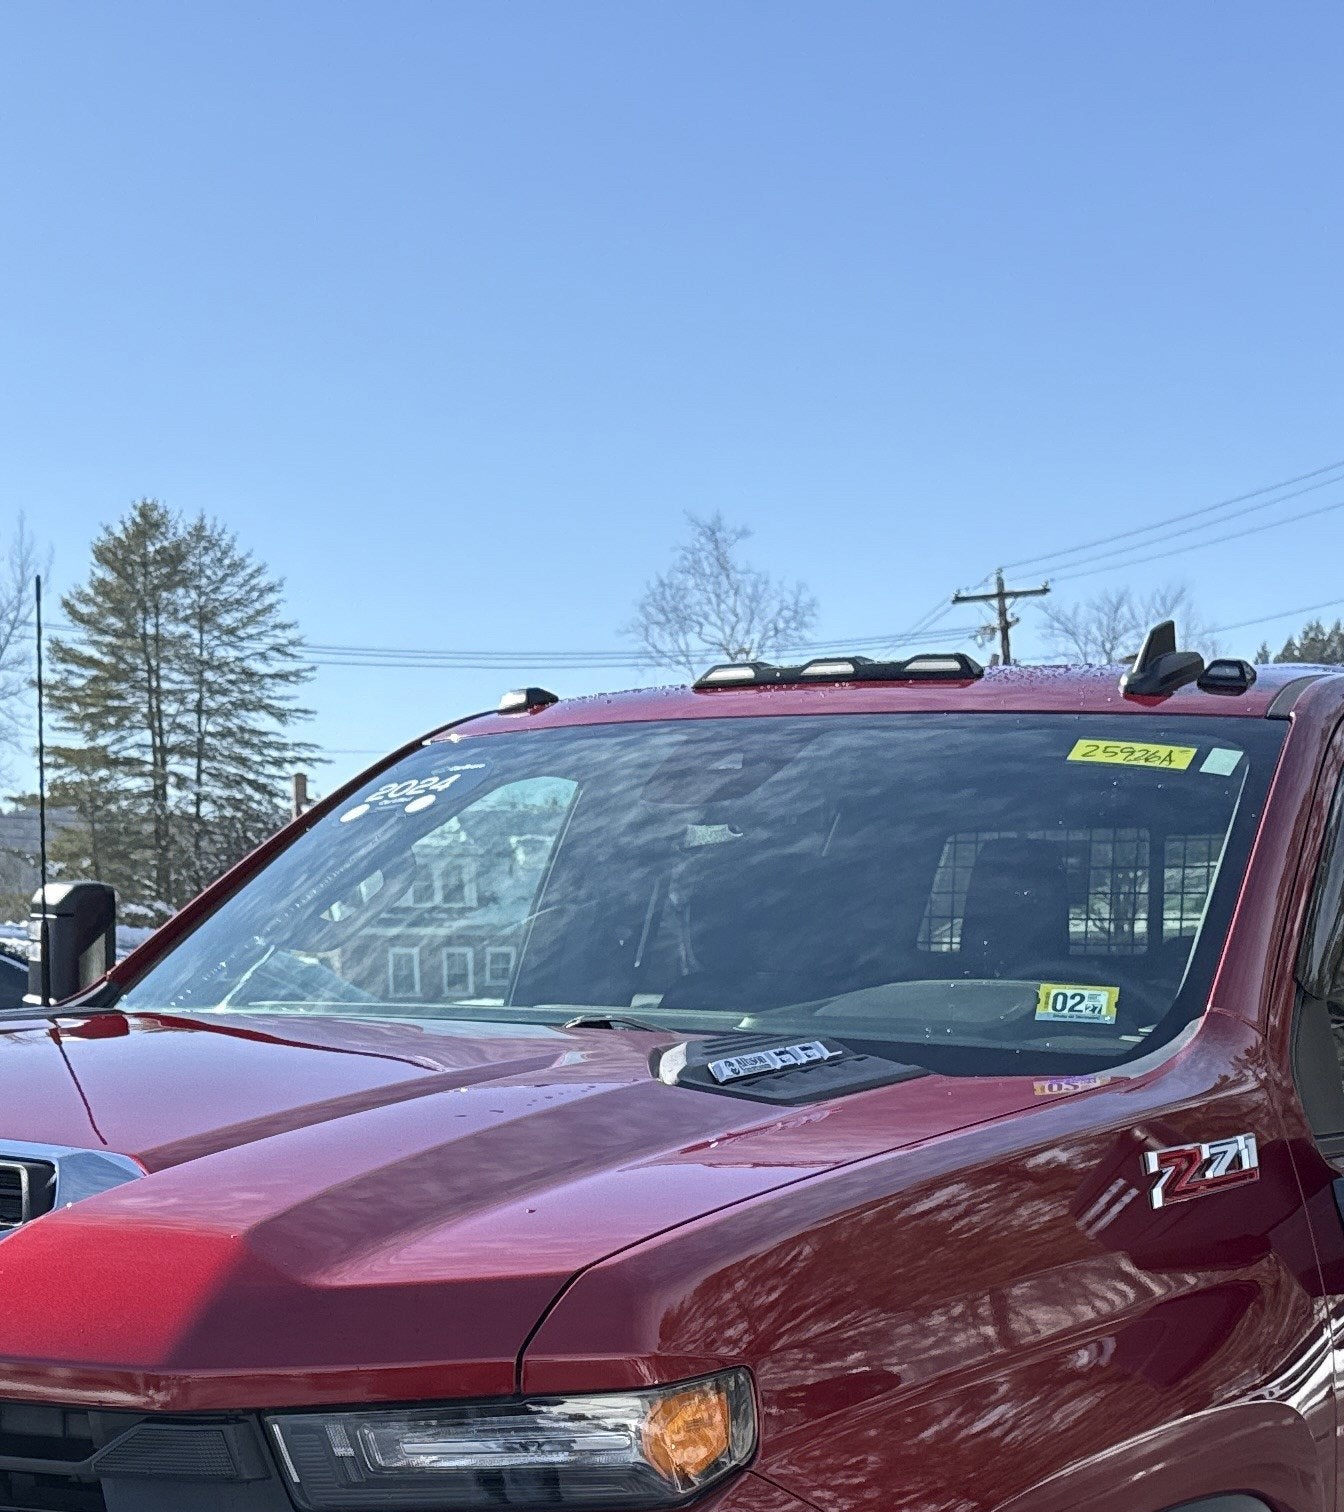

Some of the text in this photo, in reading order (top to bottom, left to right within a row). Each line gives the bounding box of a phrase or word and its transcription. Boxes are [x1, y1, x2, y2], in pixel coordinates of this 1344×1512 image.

[364, 774, 461, 803] 2024
[1051, 992, 1086, 1012] 02
[1144, 1131, 1260, 1210] Z71
